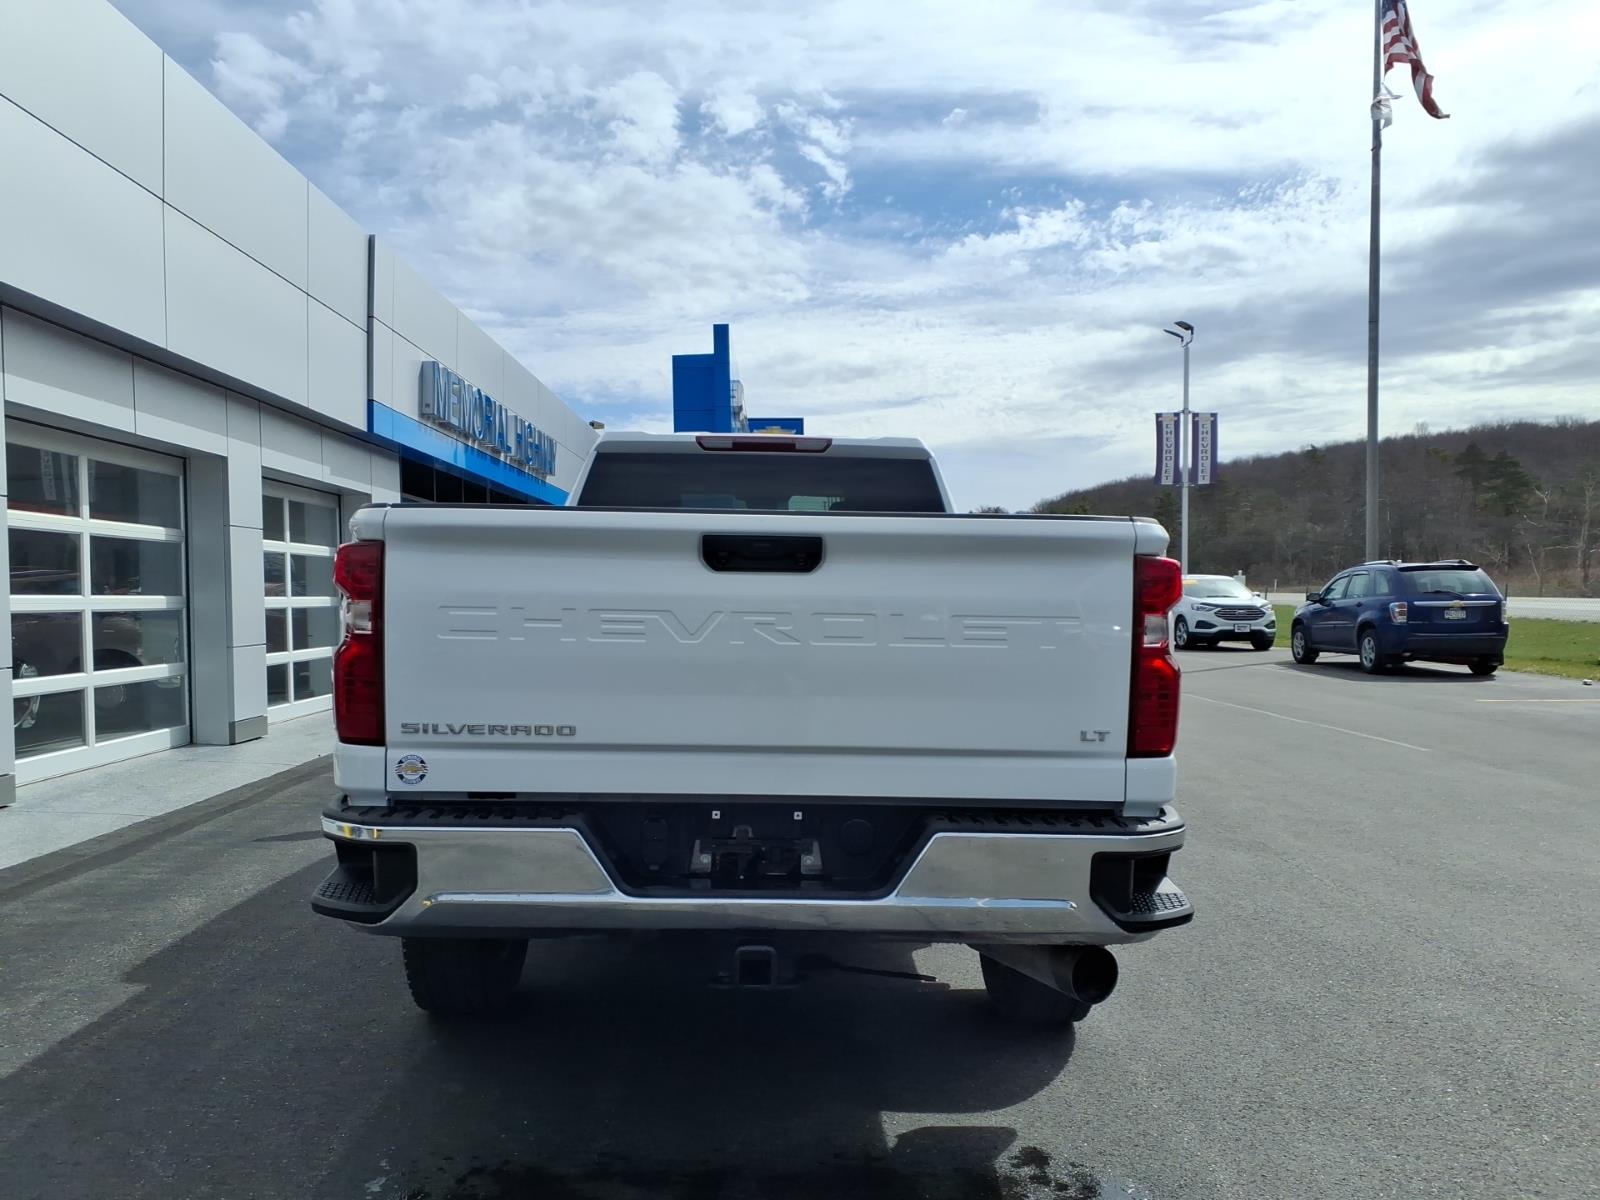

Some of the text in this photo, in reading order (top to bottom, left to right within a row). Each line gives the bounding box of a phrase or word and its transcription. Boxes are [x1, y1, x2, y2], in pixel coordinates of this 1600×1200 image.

[420, 360, 557, 476] MEMORIAL HIGHWAY
[1164, 423, 1173, 481] CHEVROLET
[1200, 423, 1209, 481] CHEVROLET
[436, 605, 1082, 650] CHEVROLET
[400, 722, 577, 737] SILVERADO
[1080, 729, 1112, 743] LT
